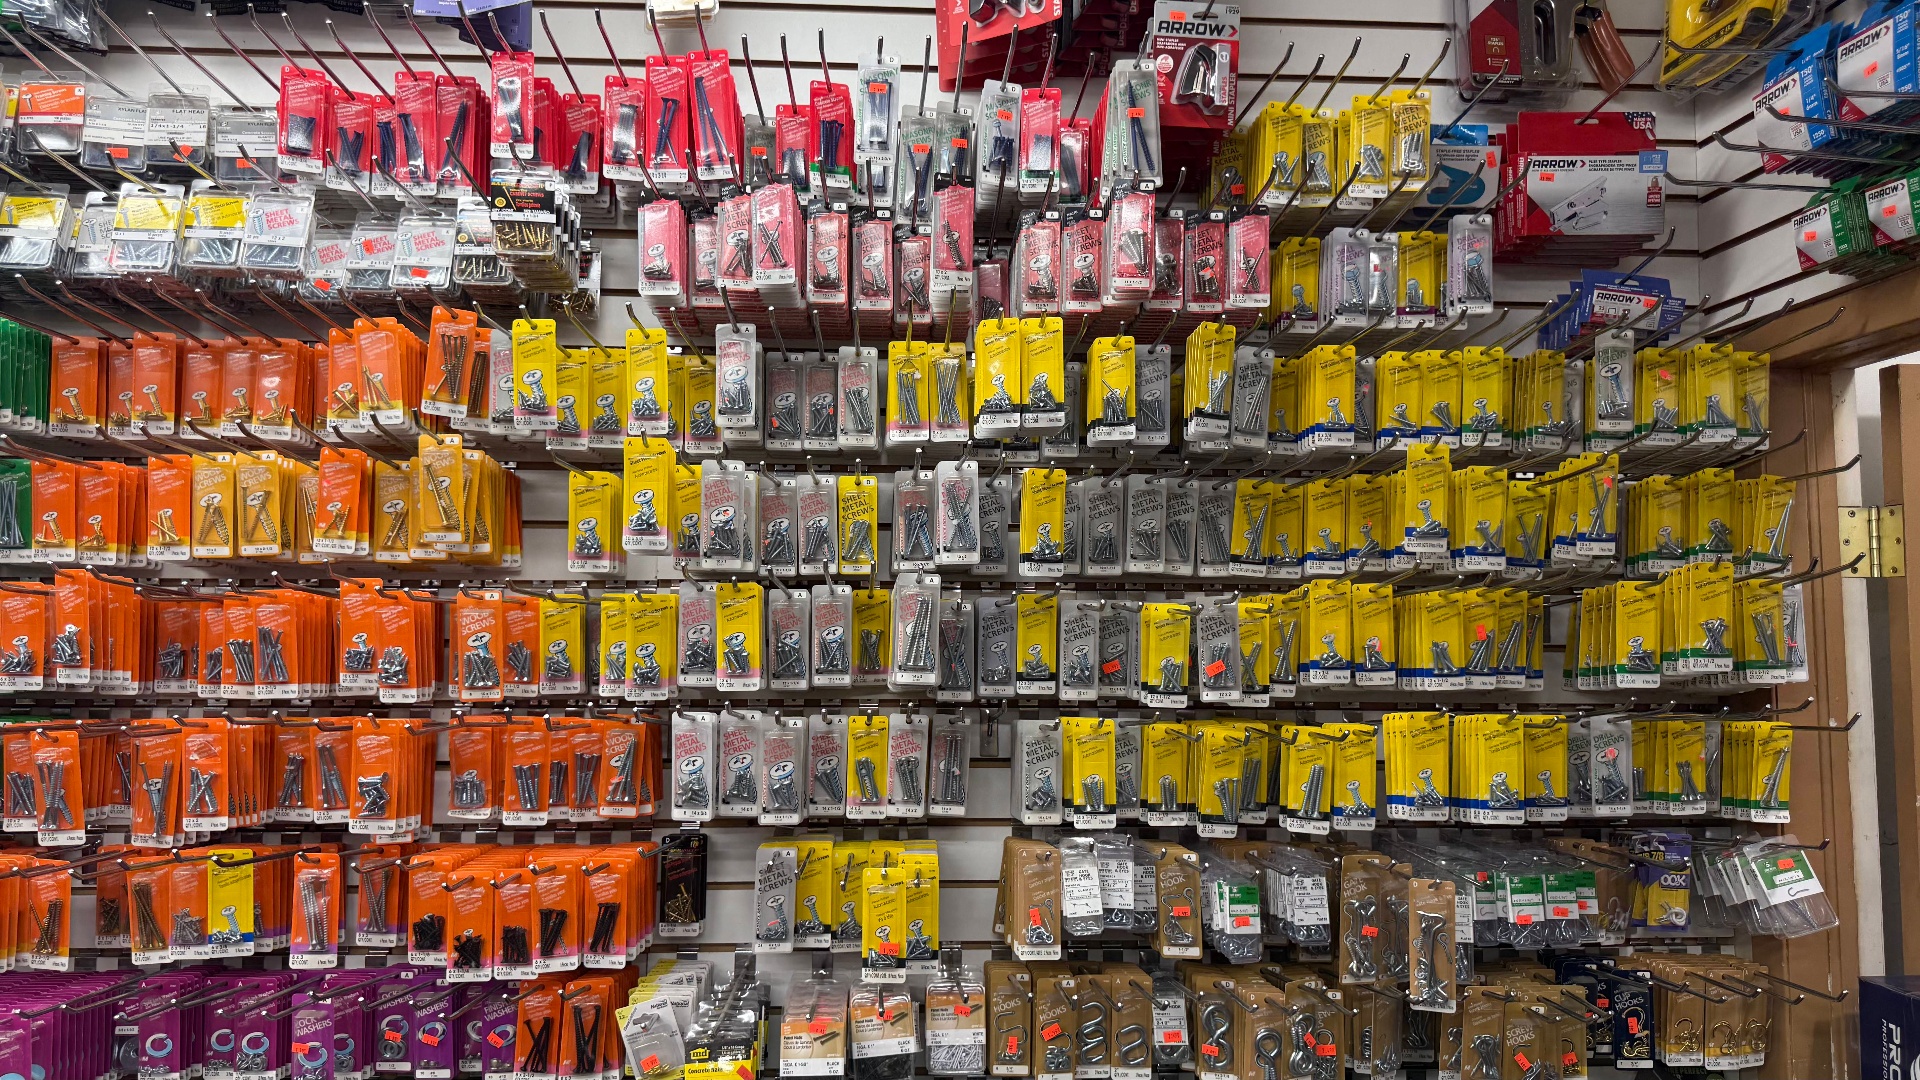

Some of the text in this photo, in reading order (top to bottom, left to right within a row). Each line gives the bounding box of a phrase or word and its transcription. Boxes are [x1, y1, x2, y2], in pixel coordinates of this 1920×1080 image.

[1157, 20, 1225, 37] ARROW
[1840, 29, 1882, 59] ARROW
[1801, 67, 1814, 77] T50
[1227, 73, 1236, 126] MINI STAPLER
[1755, 81, 1791, 111] ARROW
[1394, 113, 1427, 127] METAL
[1394, 119, 1428, 134] SCREWS
[1633, 122, 1653, 130] USA
[1812, 129, 1825, 139] 1250
[1215, 154, 1244, 166] SCREWS
[1532, 159, 1578, 169] ARROW
[1868, 182, 1899, 202] ARROW
[265, 208, 289, 218] SHEET
[265, 215, 294, 224] METAL
[1794, 208, 1822, 227] ARROW
[267, 219, 299, 230] SCREWS
[413, 231, 436, 241] SHEET
[1067, 226, 1089, 240] SHEET
[1069, 233, 1094, 247] METAL
[1457, 233, 1477, 245] DRILL
[414, 237, 440, 247] METAL
[416, 240, 446, 252] SCREWS
[1073, 240, 1102, 253] SCREWS
[317, 244, 340, 255] SHEET
[318, 249, 345, 260] METAL
[1336, 245, 1356, 257] DRILL
[1337, 250, 1364, 265] SCREWS
[1597, 294, 1635, 304] ARROW
[1135, 367, 1164, 381] METAL
[1239, 362, 1263, 375] SHEET
[1135, 372, 1168, 388] SCREWS
[705, 479, 729, 492] SHEET
[705, 488, 732, 500] METAL
[800, 492, 822, 504] SHEET
[842, 494, 867, 505] SHEET
[1089, 490, 1113, 504] SHEET
[1131, 489, 1156, 502] SHEET
[705, 493, 740, 510] SCREWS
[800, 499, 825, 511] METAL
[842, 500, 870, 513] METAL
[1089, 498, 1117, 512] METAL
[1131, 497, 1159, 510] METAL
[801, 504, 832, 519] SCREWS
[842, 505, 875, 522] SCREWS
[1088, 504, 1120, 520] SCREWS
[1131, 503, 1163, 519] SCREWS
[682, 598, 706, 611] SHEET
[460, 612, 489, 625] WOOD
[682, 606, 708, 619] METAL
[682, 611, 715, 628] SCREWS
[815, 609, 842, 622] METAL
[461, 618, 496, 636] SCREWS
[815, 615, 846, 630] SCREWS
[982, 619, 1009, 633] METAL
[1064, 614, 1088, 628] SHEET
[1064, 621, 1091, 635] METAL
[1200, 620, 1229, 633] METAL
[981, 625, 1015, 641] SCREWS
[1063, 627, 1097, 644] SCREWS
[606, 733, 634, 746] WOOD
[676, 735, 700, 750] METAL
[724, 736, 750, 750] METAL
[891, 732, 915, 745] SHEET
[1593, 733, 1614, 743] DRILL
[1593, 736, 1624, 750] SCREWS
[676, 742, 707, 760] SCREWS
[724, 741, 756, 757] SCREWS
[891, 739, 919, 753] METAL
[891, 743, 922, 760] SCREWS
[1025, 741, 1054, 758] METAL
[1025, 749, 1060, 767] SCREWS
[1650, 852, 1664, 860] 7/8
[759, 869, 788, 886] METAL
[1161, 875, 1186, 888] HOOK
[758, 876, 793, 894] SCREWS
[1343, 885, 1368, 898] HOOK
[650, 1000, 667, 1010] National
[994, 997, 1021, 1013] HOOKS
[1614, 994, 1631, 1003] CUP
[1615, 996, 1644, 1010] HOOKS
[416, 1002, 449, 1018] WASHERS
[1039, 1002, 1051, 1010] "S"
[1040, 1005, 1067, 1021] HOOKS
[295, 1018, 332, 1036] WASHERS
[1506, 1024, 1532, 1039] SCREW
[1506, 1032, 1535, 1046] HOOKS
[692, 1050, 708, 1059] md
